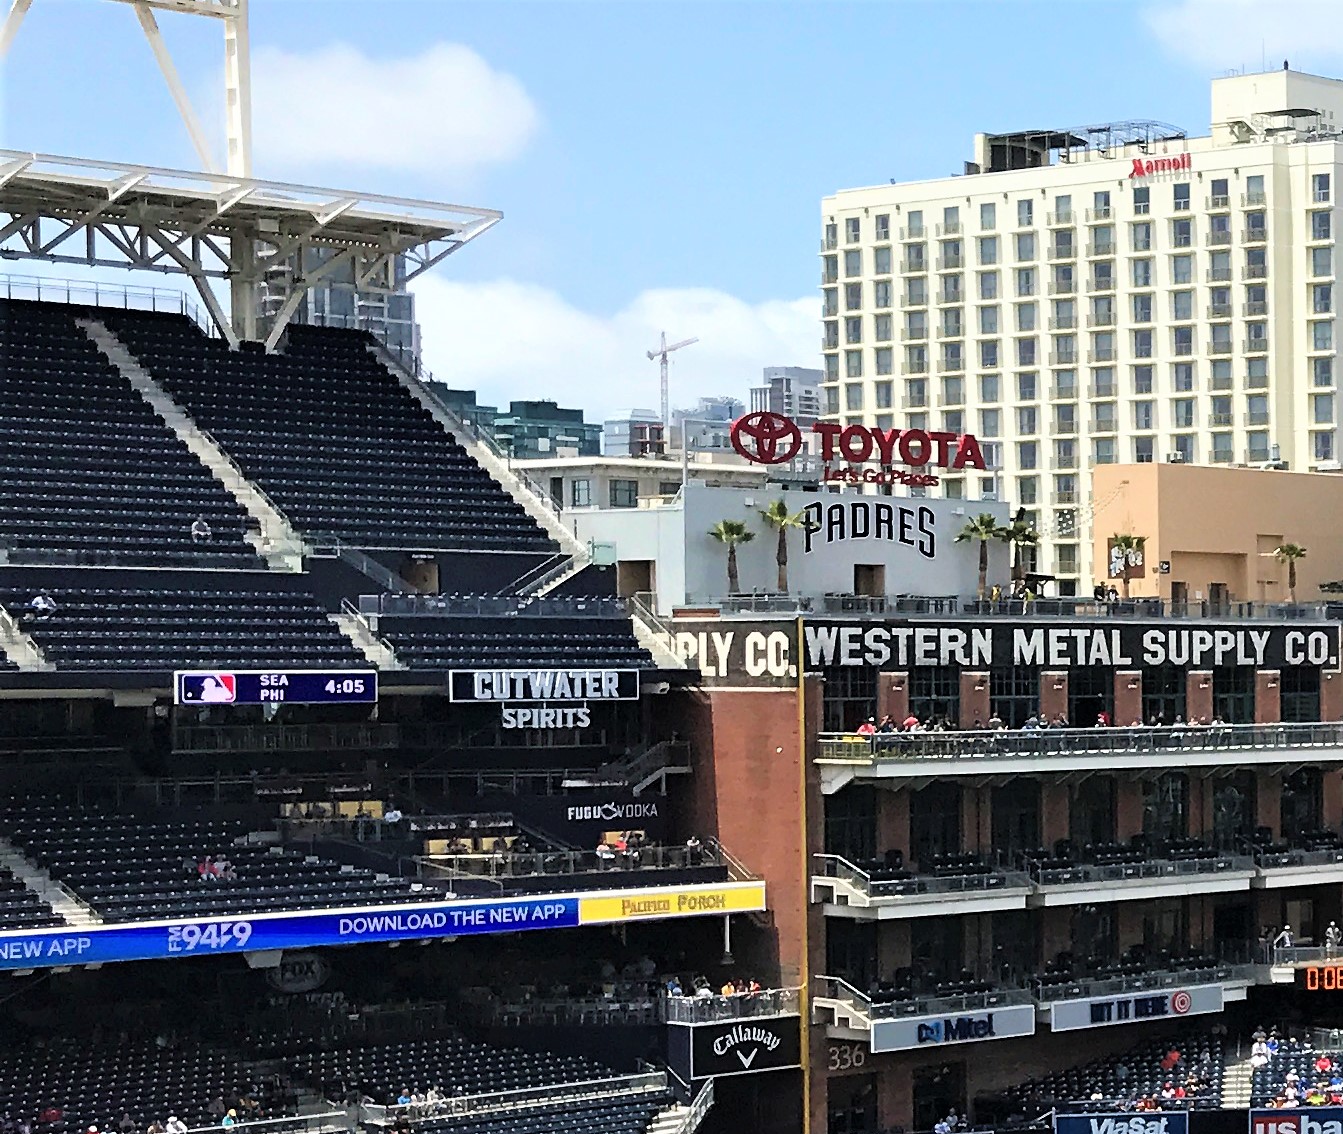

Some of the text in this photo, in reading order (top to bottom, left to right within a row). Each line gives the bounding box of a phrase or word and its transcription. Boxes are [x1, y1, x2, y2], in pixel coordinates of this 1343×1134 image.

[812, 422, 986, 470] TOYOTA
[891, 470, 939, 487] Places
[802, 501, 936, 559] PADRES
[745, 631, 797, 678] CO.
[804, 626, 1336, 666] WESTERN METAL SUPPLY CO.
[260, 674, 289, 686] SEA
[324, 679, 365, 694] 4:05
[474, 671, 619, 699] CUTWATER
[260, 689, 284, 701] PHI
[502, 708, 591, 728] SPIRITS
[567, 803, 658, 820] FUGU VODKA
[339, 903, 566, 934] DOWNLOAD THE NEW APP
[47, 938, 91, 957] APP
[713, 1024, 782, 1056] Callaway
[827, 1044, 865, 1071] 336
